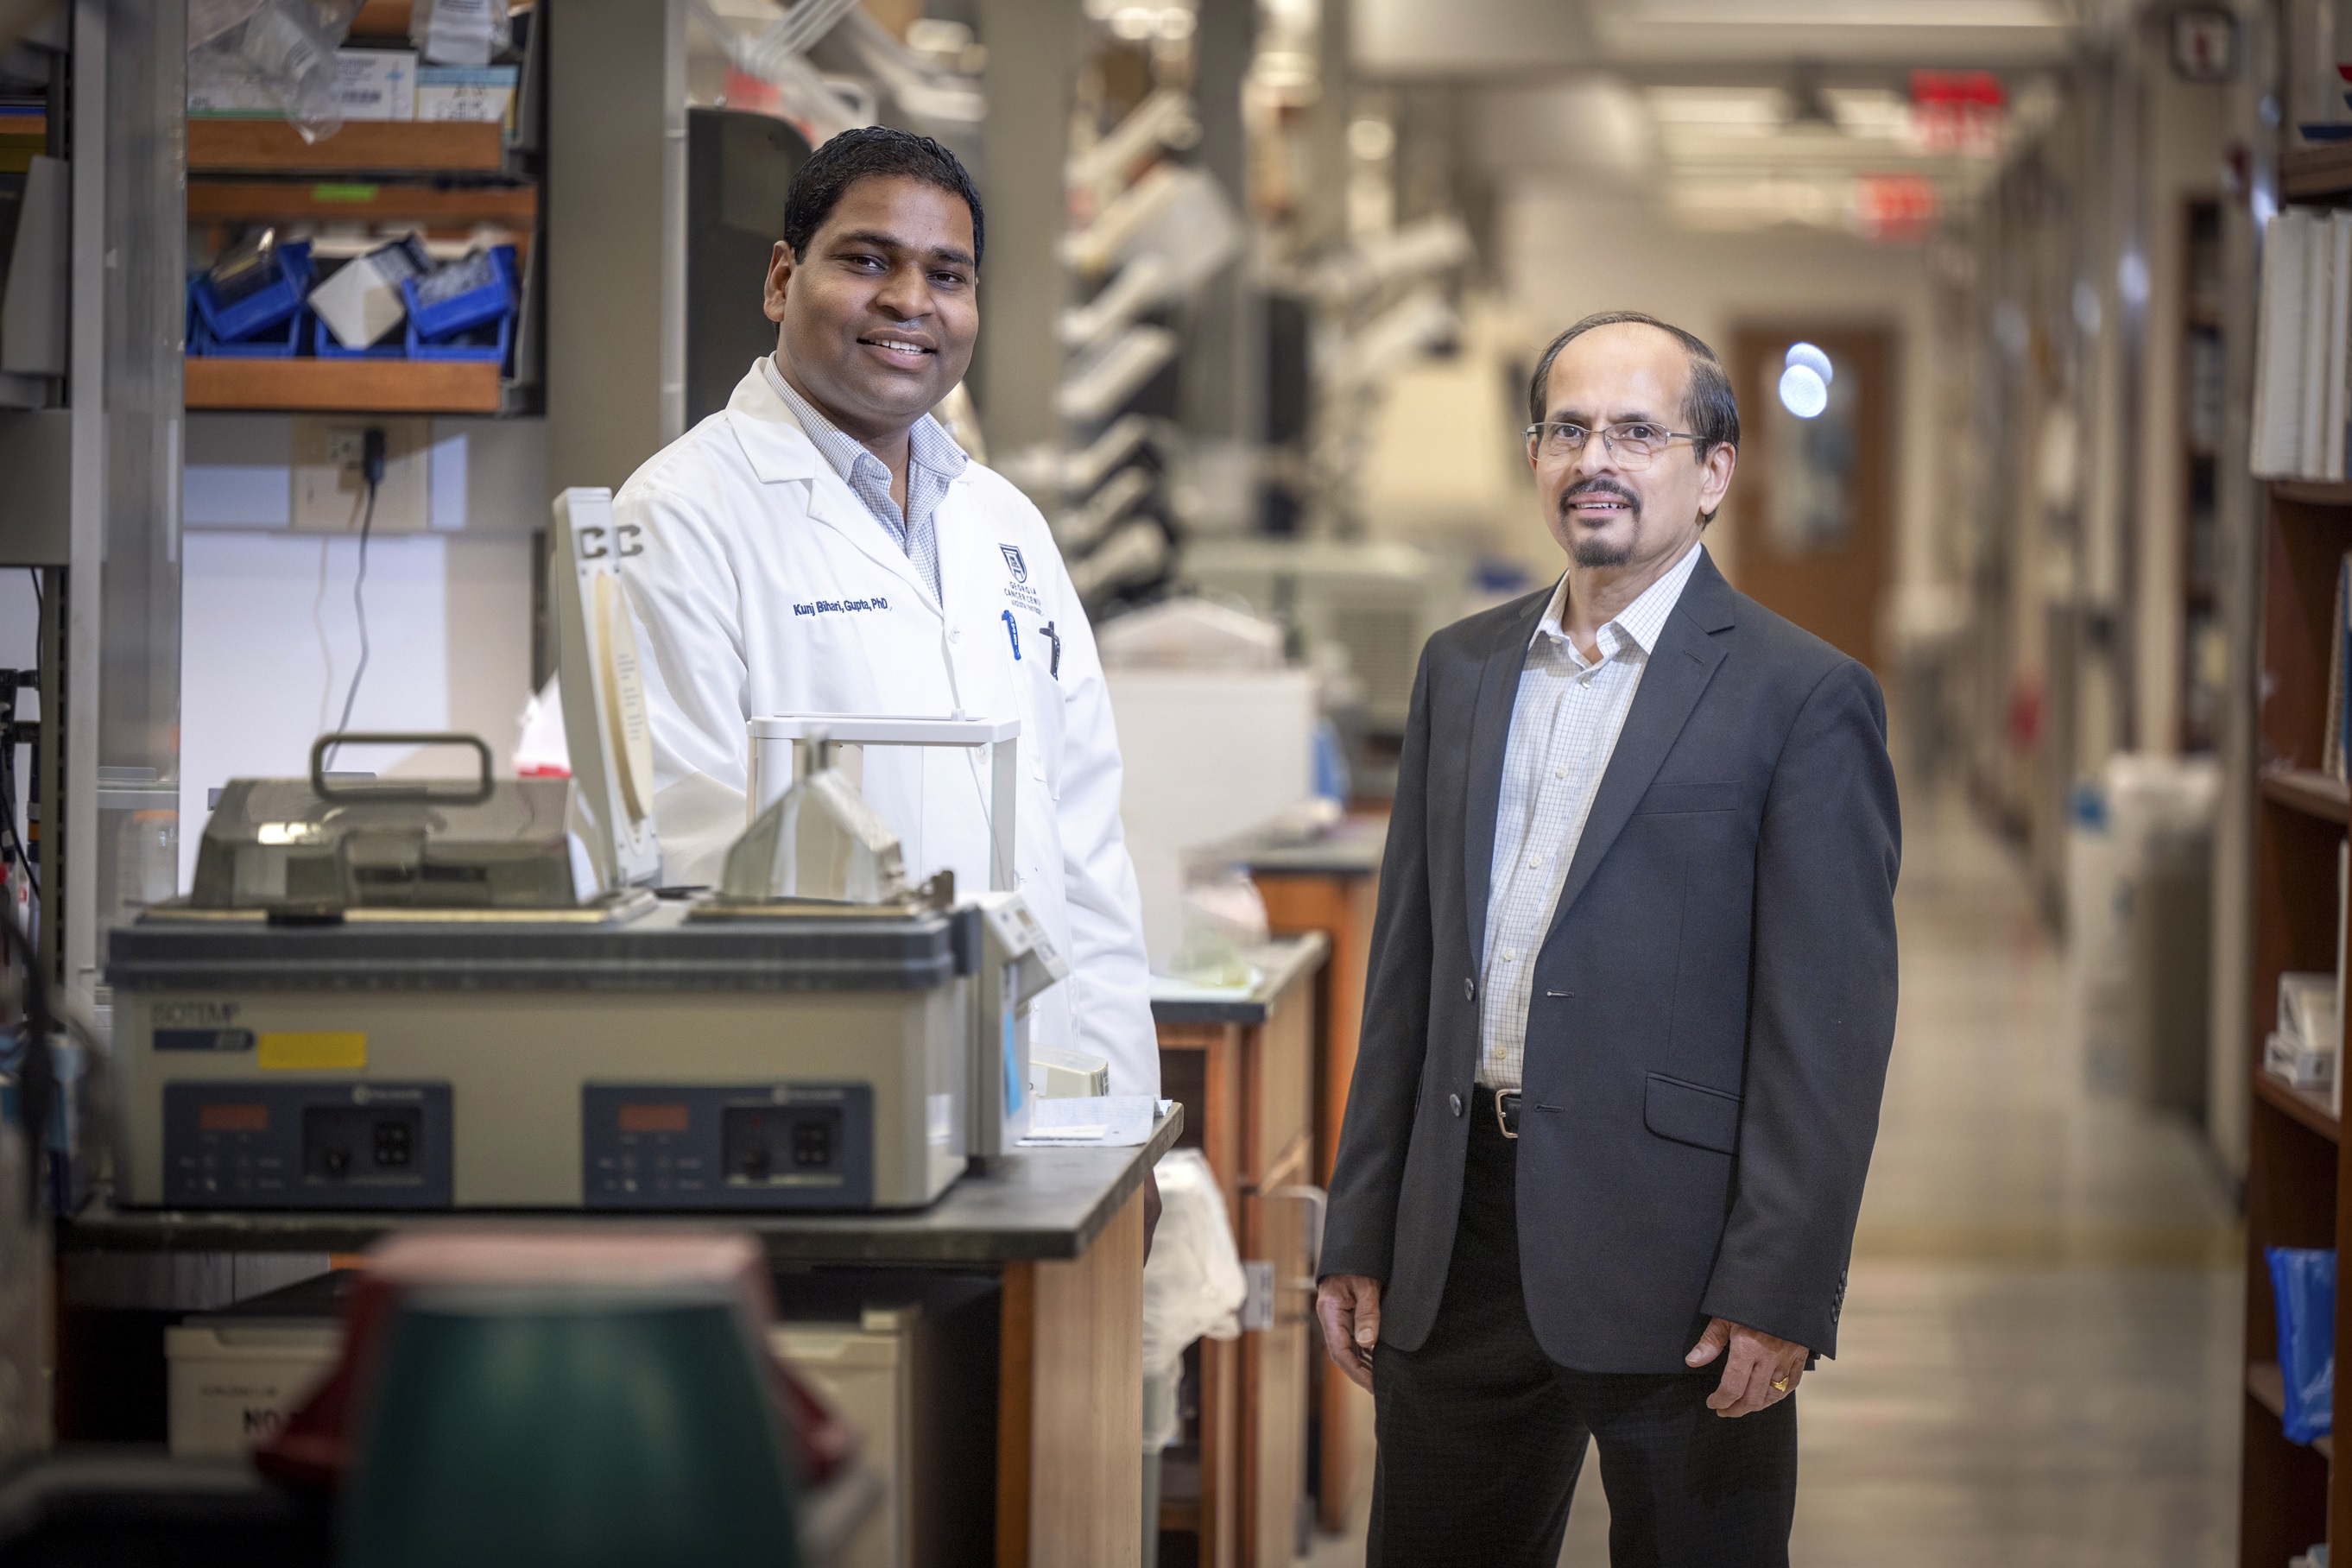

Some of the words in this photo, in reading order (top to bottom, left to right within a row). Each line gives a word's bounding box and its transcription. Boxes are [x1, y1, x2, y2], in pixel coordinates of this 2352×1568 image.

[1004, 588, 1027, 602] CANCER
[1009, 581, 1037, 596] GEORGIA
[793, 603, 815, 616] Kunj
[816, 600, 844, 613] Bihari,
[844, 599, 872, 612] Gupta,
[870, 597, 888, 610] PhD
